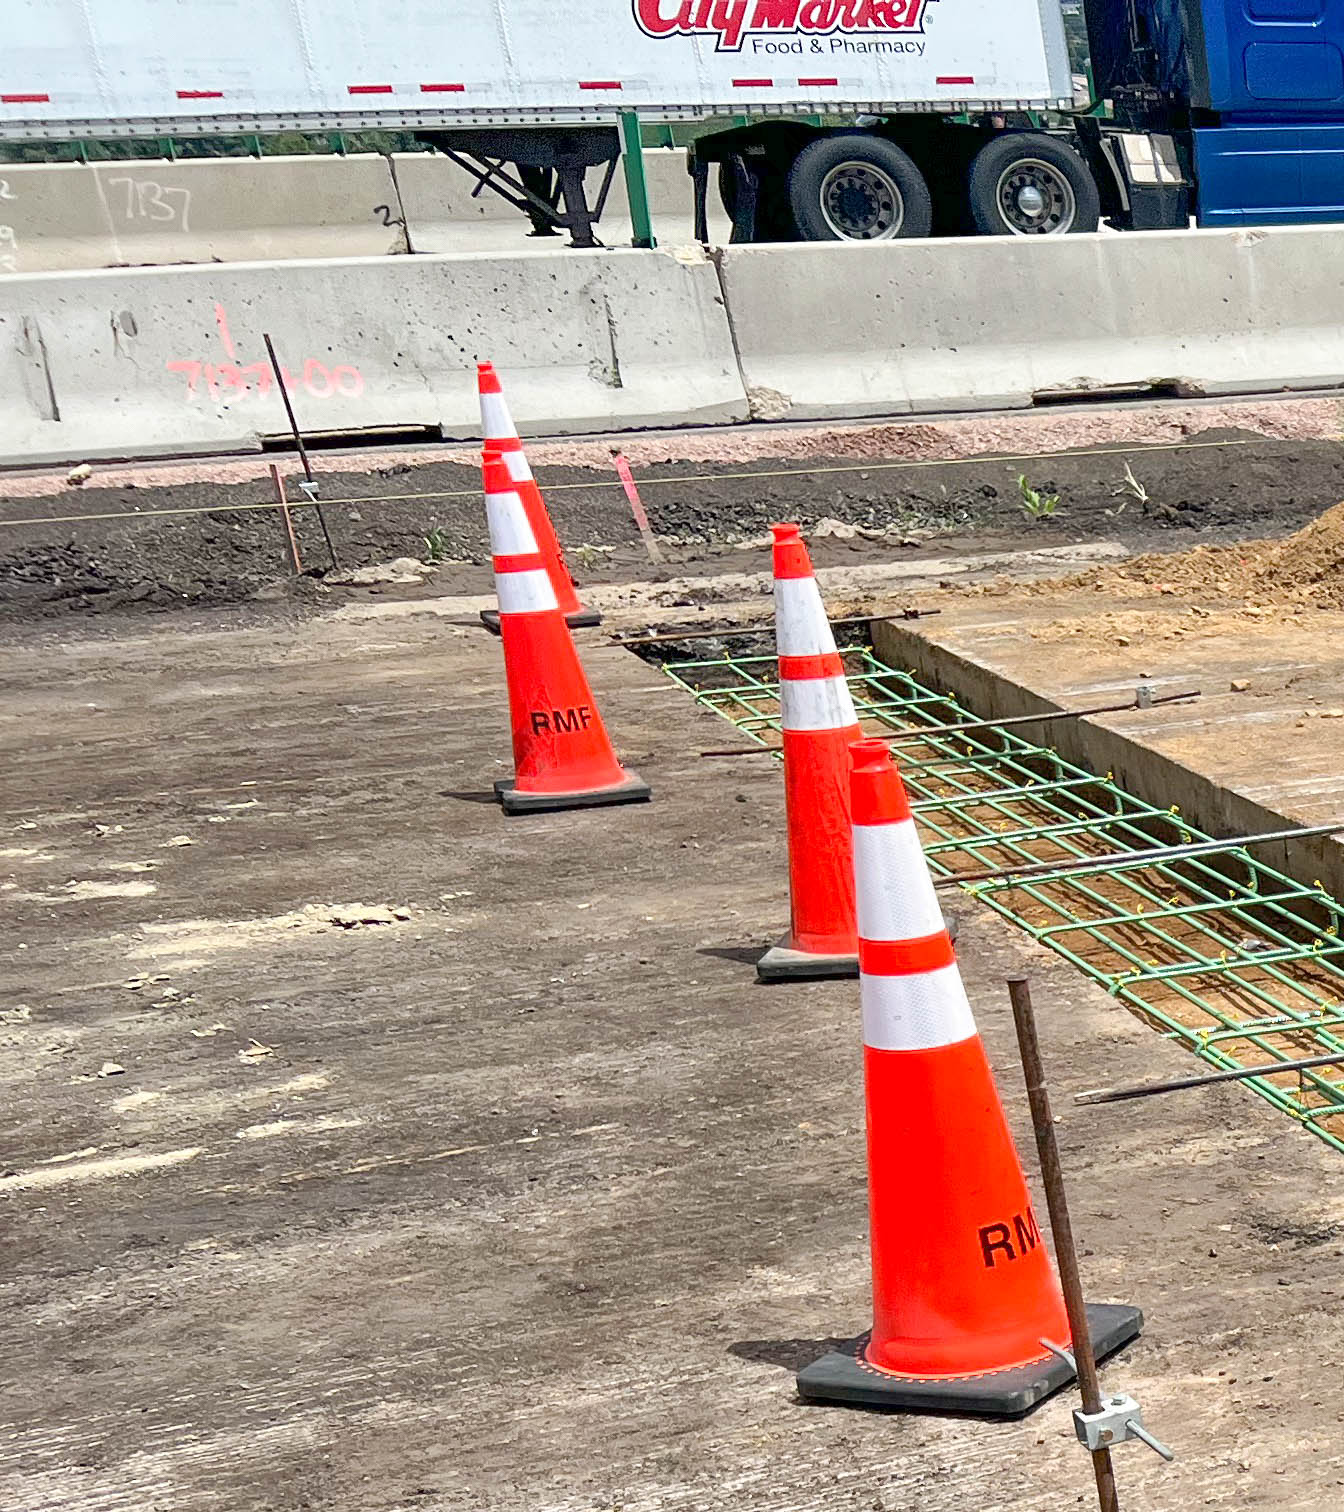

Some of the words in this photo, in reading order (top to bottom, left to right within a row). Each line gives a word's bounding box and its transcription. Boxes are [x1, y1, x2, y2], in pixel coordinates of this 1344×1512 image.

[752, 39, 803, 54] Food
[809, 38, 825, 54] &
[829, 38, 926, 57] Pharmacy
[530, 706, 592, 736] RMF
